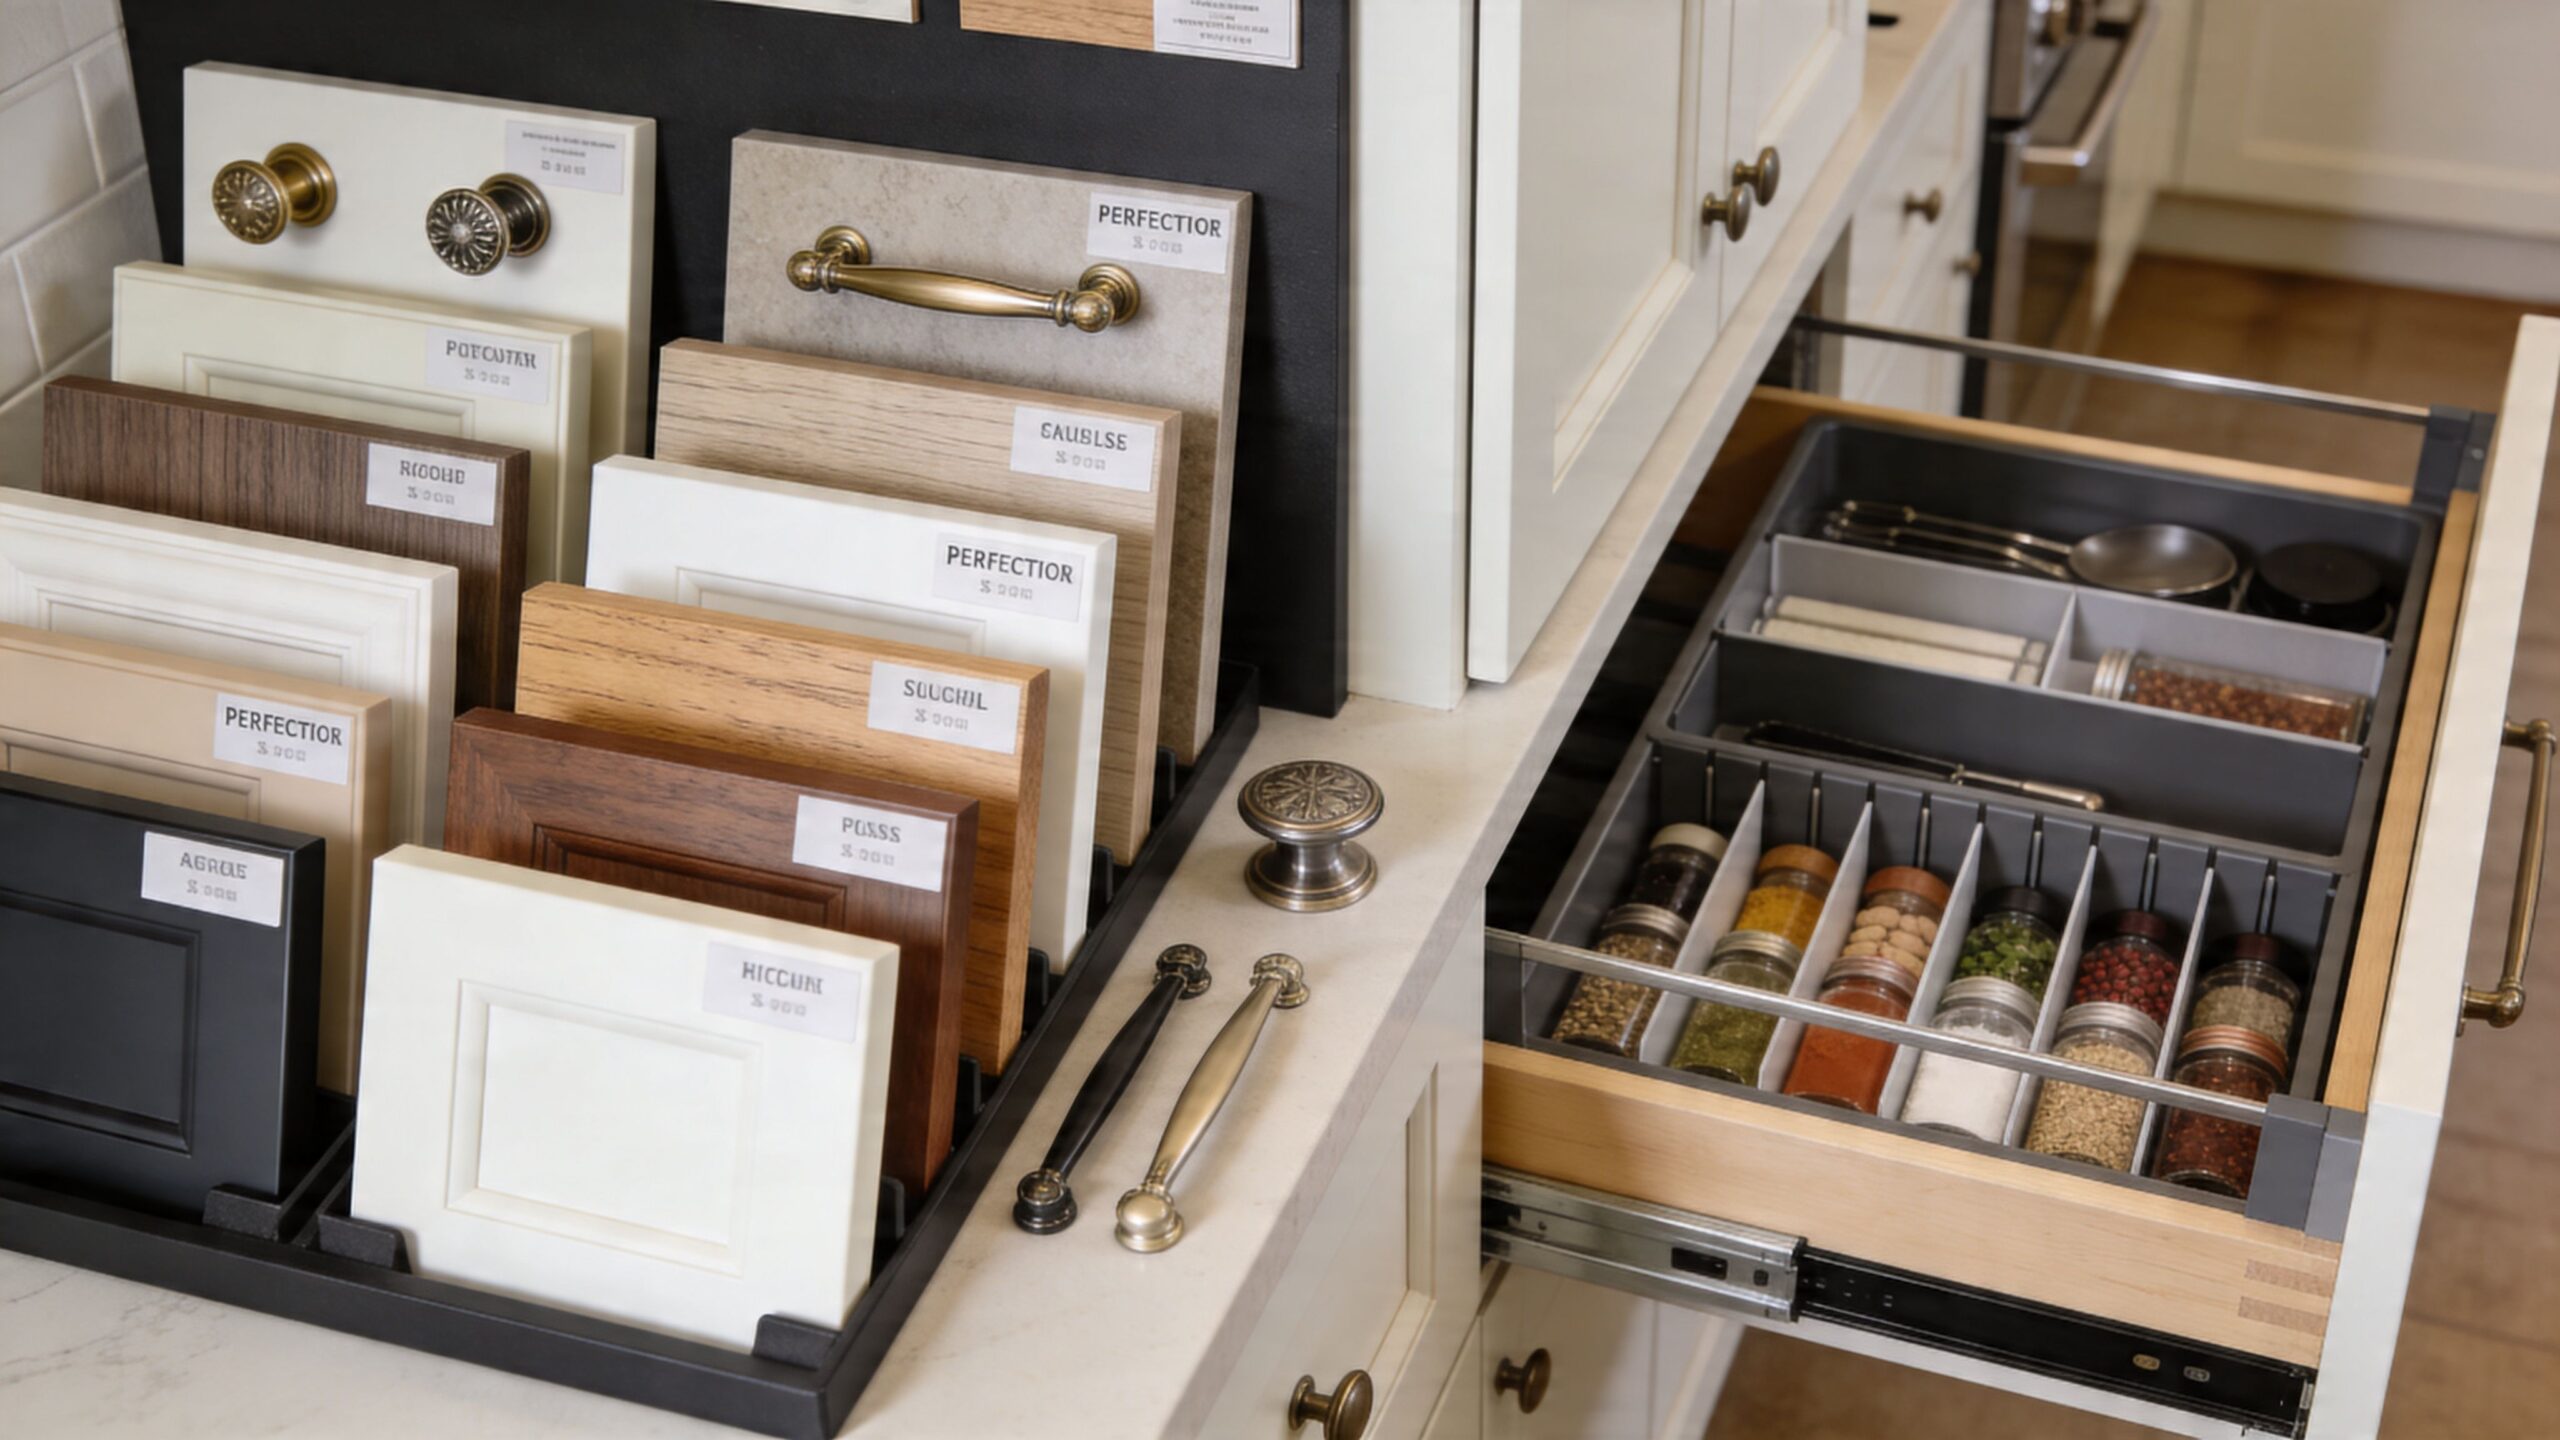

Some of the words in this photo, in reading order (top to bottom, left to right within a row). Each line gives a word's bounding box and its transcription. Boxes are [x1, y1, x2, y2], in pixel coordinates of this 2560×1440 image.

[1098, 205, 1221, 238] PERFECTIOR
[947, 545, 1073, 584] PERFECTIOR
[226, 707, 342, 745] PERFECTIOR
